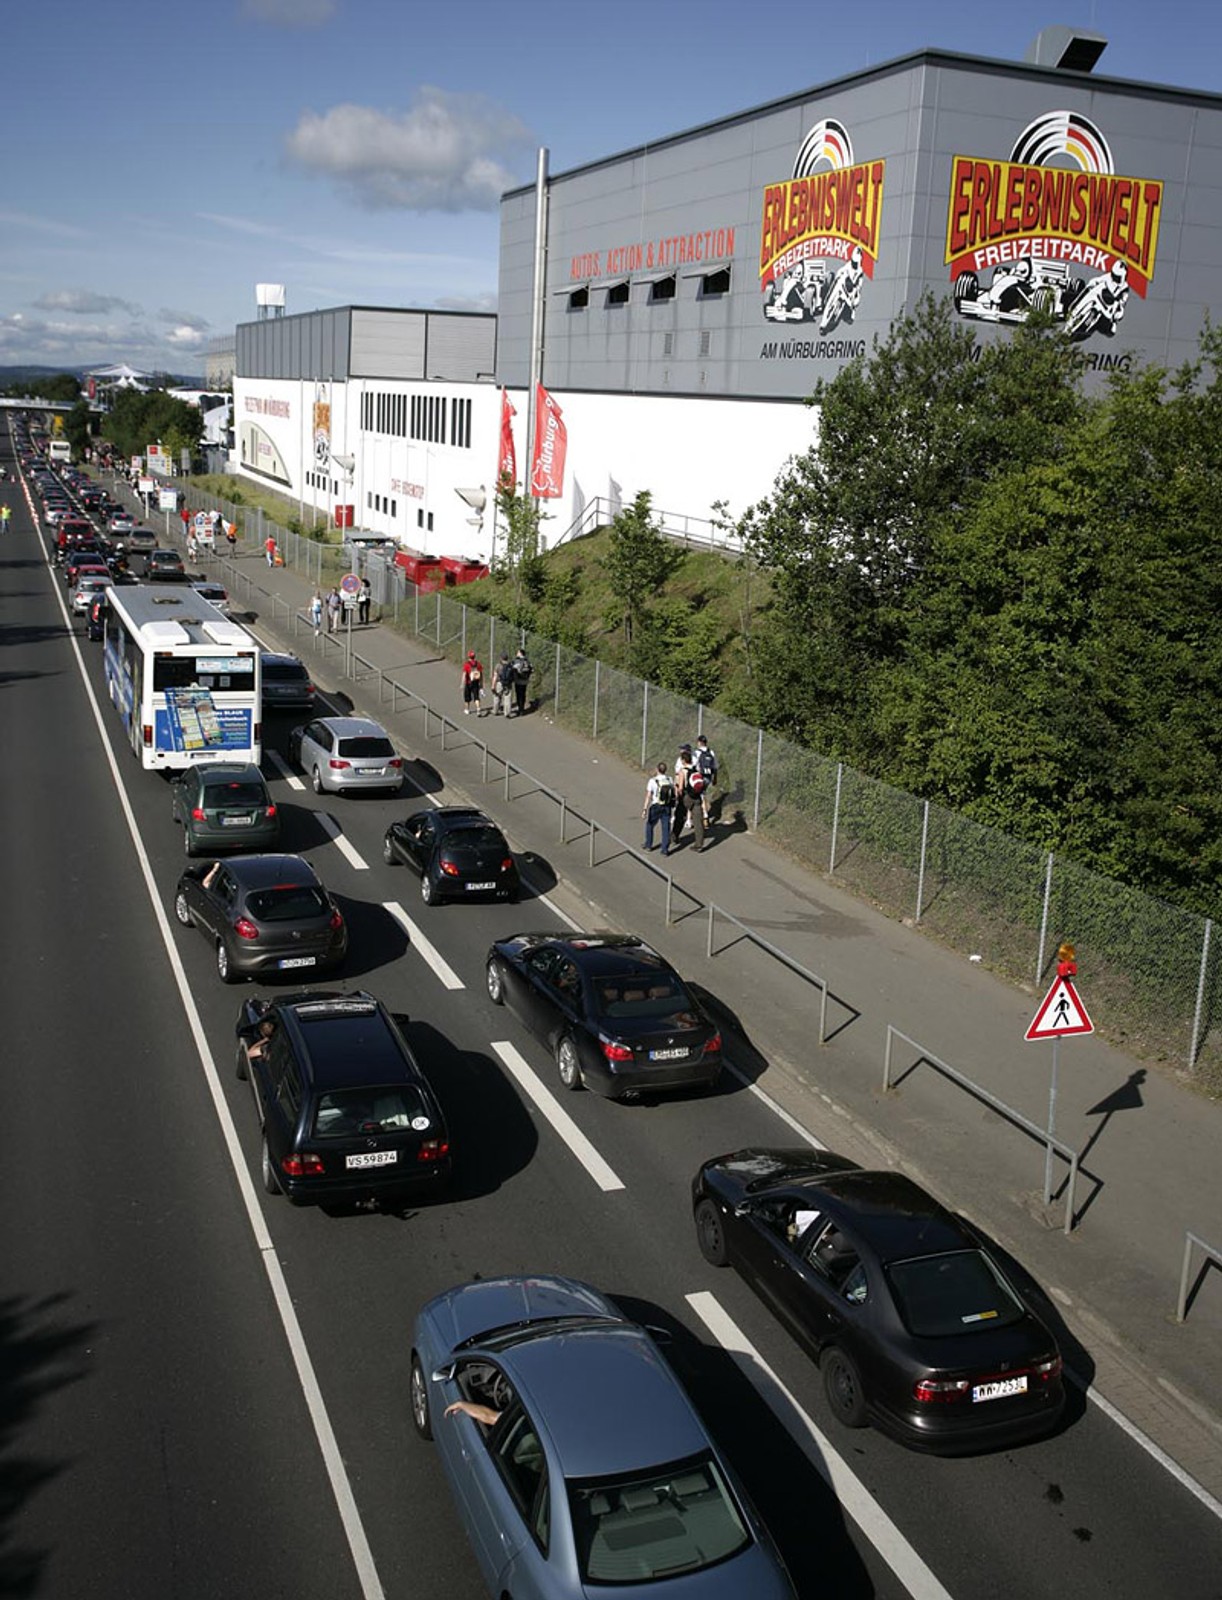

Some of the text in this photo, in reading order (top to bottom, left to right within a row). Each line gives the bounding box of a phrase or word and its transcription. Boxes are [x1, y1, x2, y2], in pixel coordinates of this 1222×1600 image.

[760, 161, 884, 269] ERLEBNISWELT
[950, 159, 1160, 270] ERLEBNISWELT
[606, 243, 643, 274] ACTION
[646, 241, 654, 269] &
[658, 227, 736, 267] ATTRACTION
[773, 238, 851, 278] FREIZEITPARK
[974, 238, 1110, 271] FREIZEITPARK
[760, 338, 866, 359] AM NÜRBURGRING
